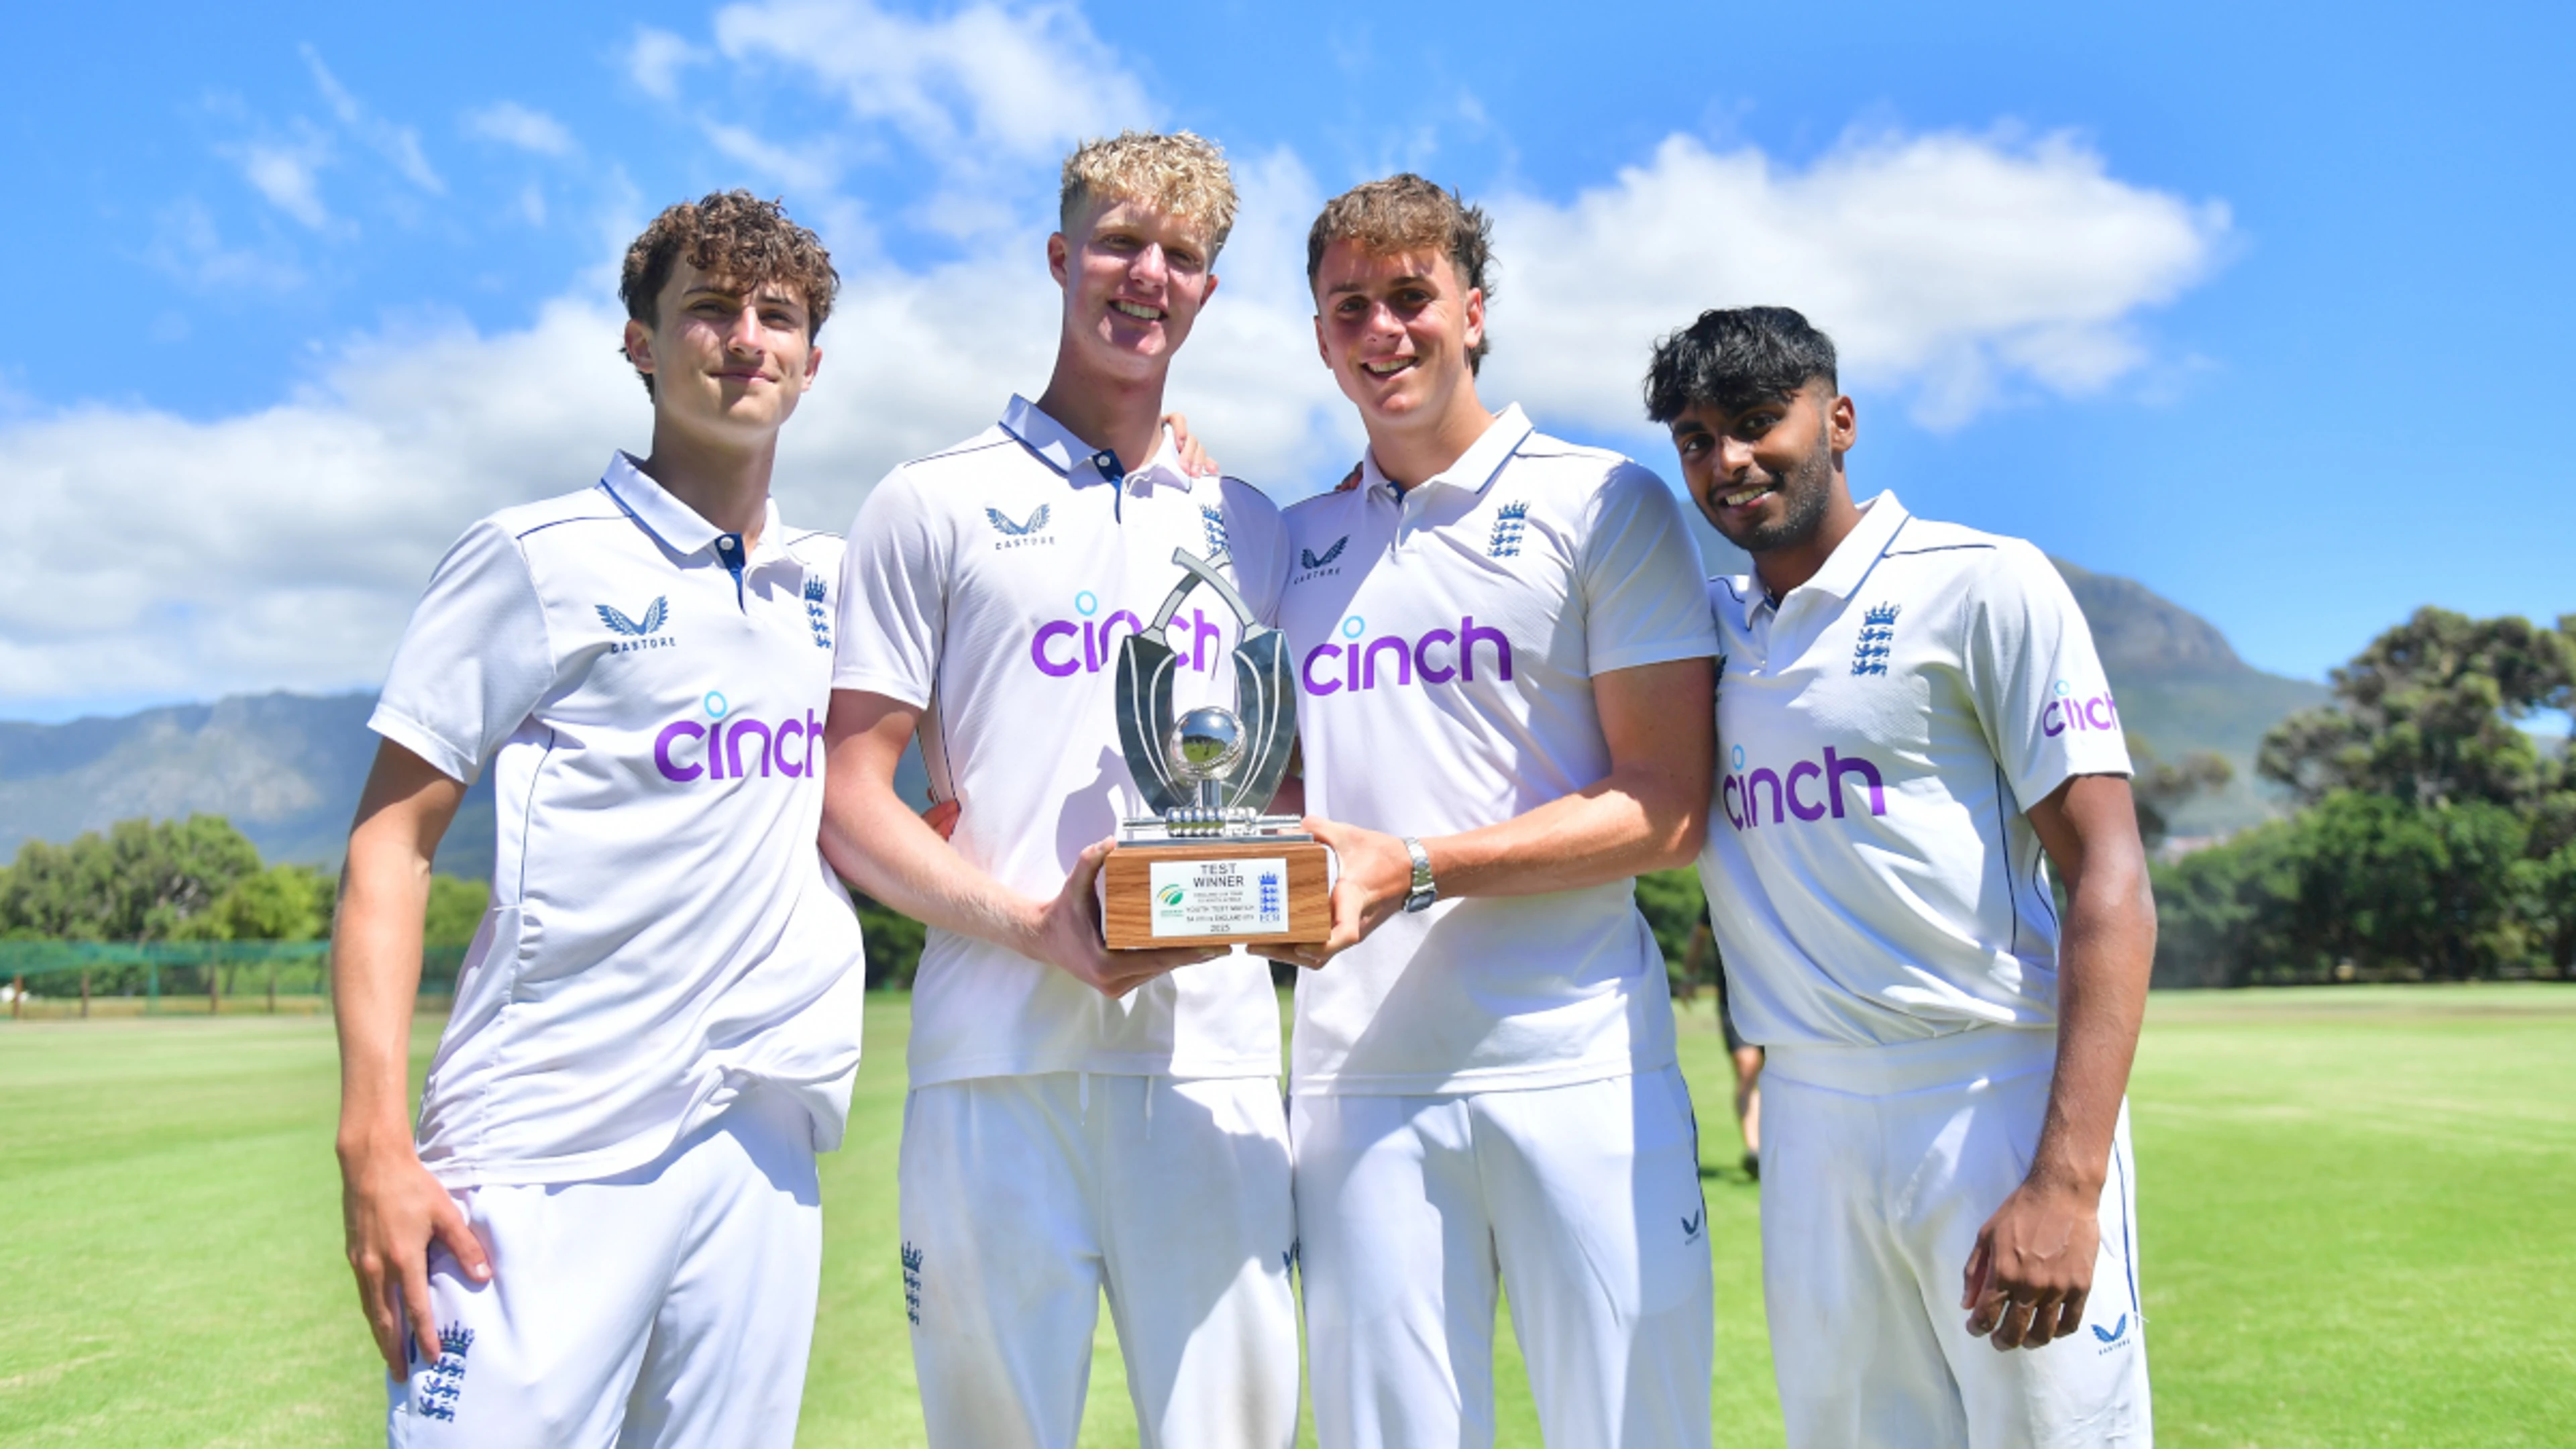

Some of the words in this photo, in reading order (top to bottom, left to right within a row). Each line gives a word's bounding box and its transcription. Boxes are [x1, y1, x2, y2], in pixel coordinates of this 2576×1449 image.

[995, 536, 1055, 550] CASTORE
[611, 637, 676, 654] CASTORE
[1303, 616, 1512, 696] cinch
[654, 691, 824, 782] cinch
[1723, 744, 1887, 831] cinch
[1199, 863, 1237, 874] TEST
[1193, 875, 1245, 888] WINNER
